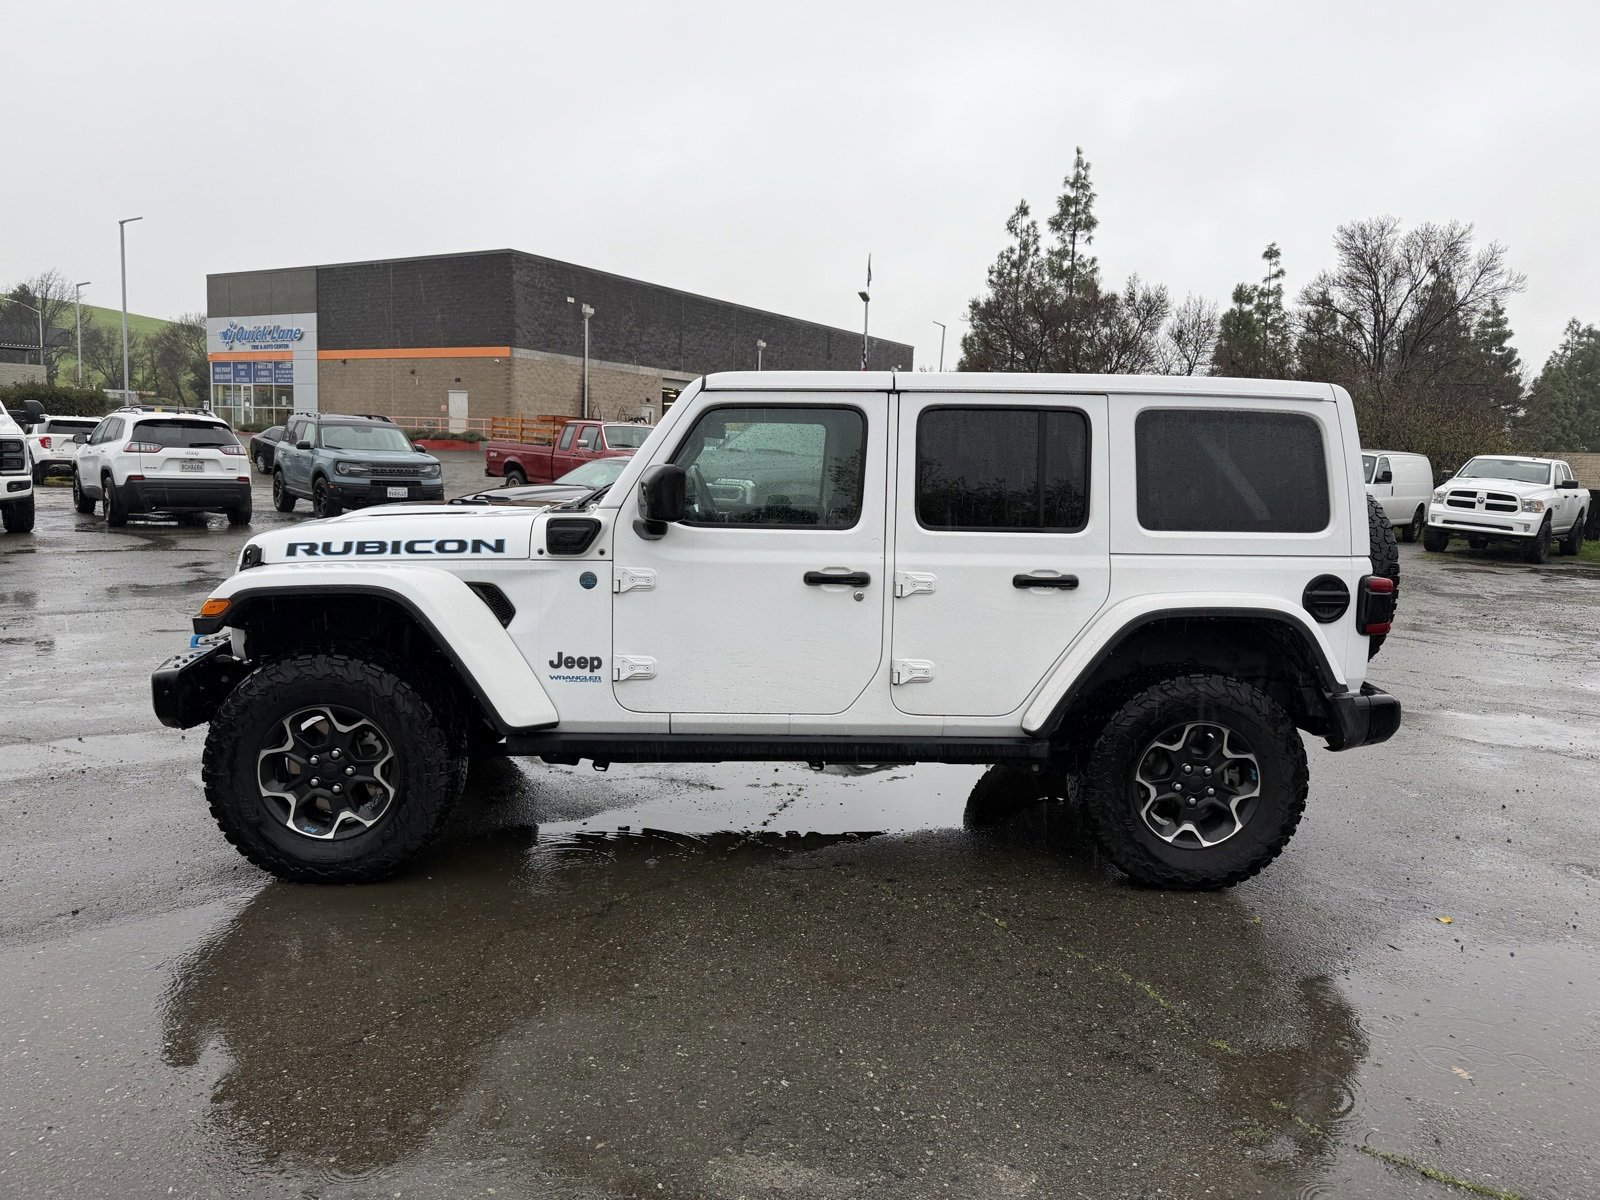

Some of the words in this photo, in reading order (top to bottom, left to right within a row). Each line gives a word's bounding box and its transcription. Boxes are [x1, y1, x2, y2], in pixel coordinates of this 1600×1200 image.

[236, 326, 268, 343] Quick
[271, 326, 302, 341] Lane
[285, 538, 506, 557] RUBICON
[549, 651, 602, 673] Jeep
